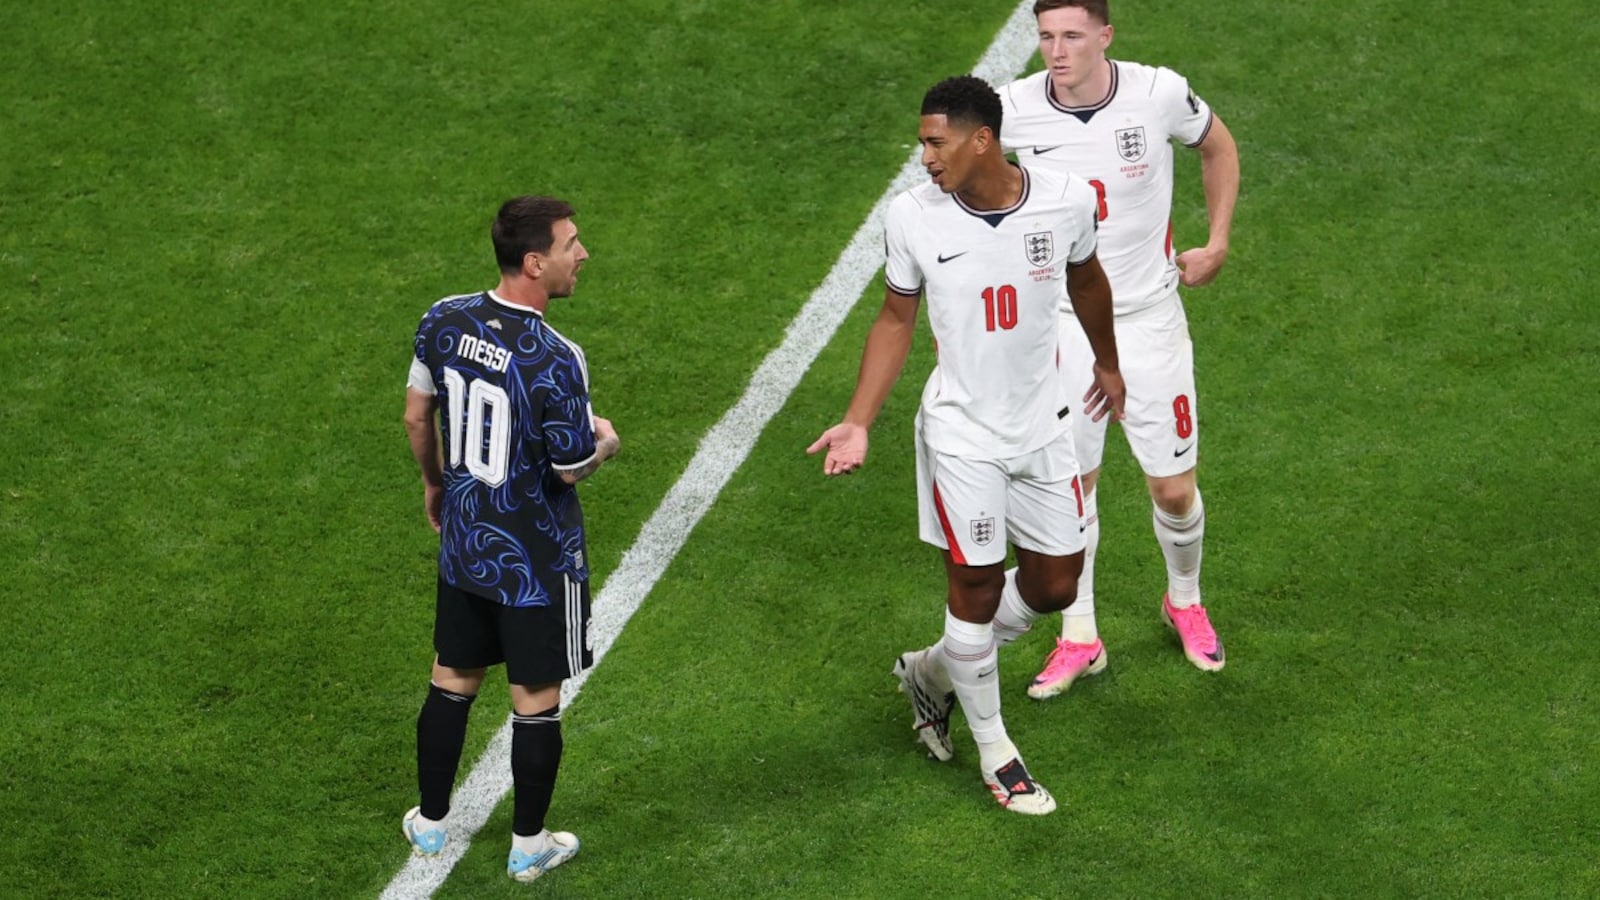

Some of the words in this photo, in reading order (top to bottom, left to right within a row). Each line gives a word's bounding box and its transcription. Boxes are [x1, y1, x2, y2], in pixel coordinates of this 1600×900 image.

[981, 284, 1018, 332] 10
[457, 333, 513, 373] MESSI
[443, 366, 512, 489] 10
[1173, 394, 1192, 440] 8
